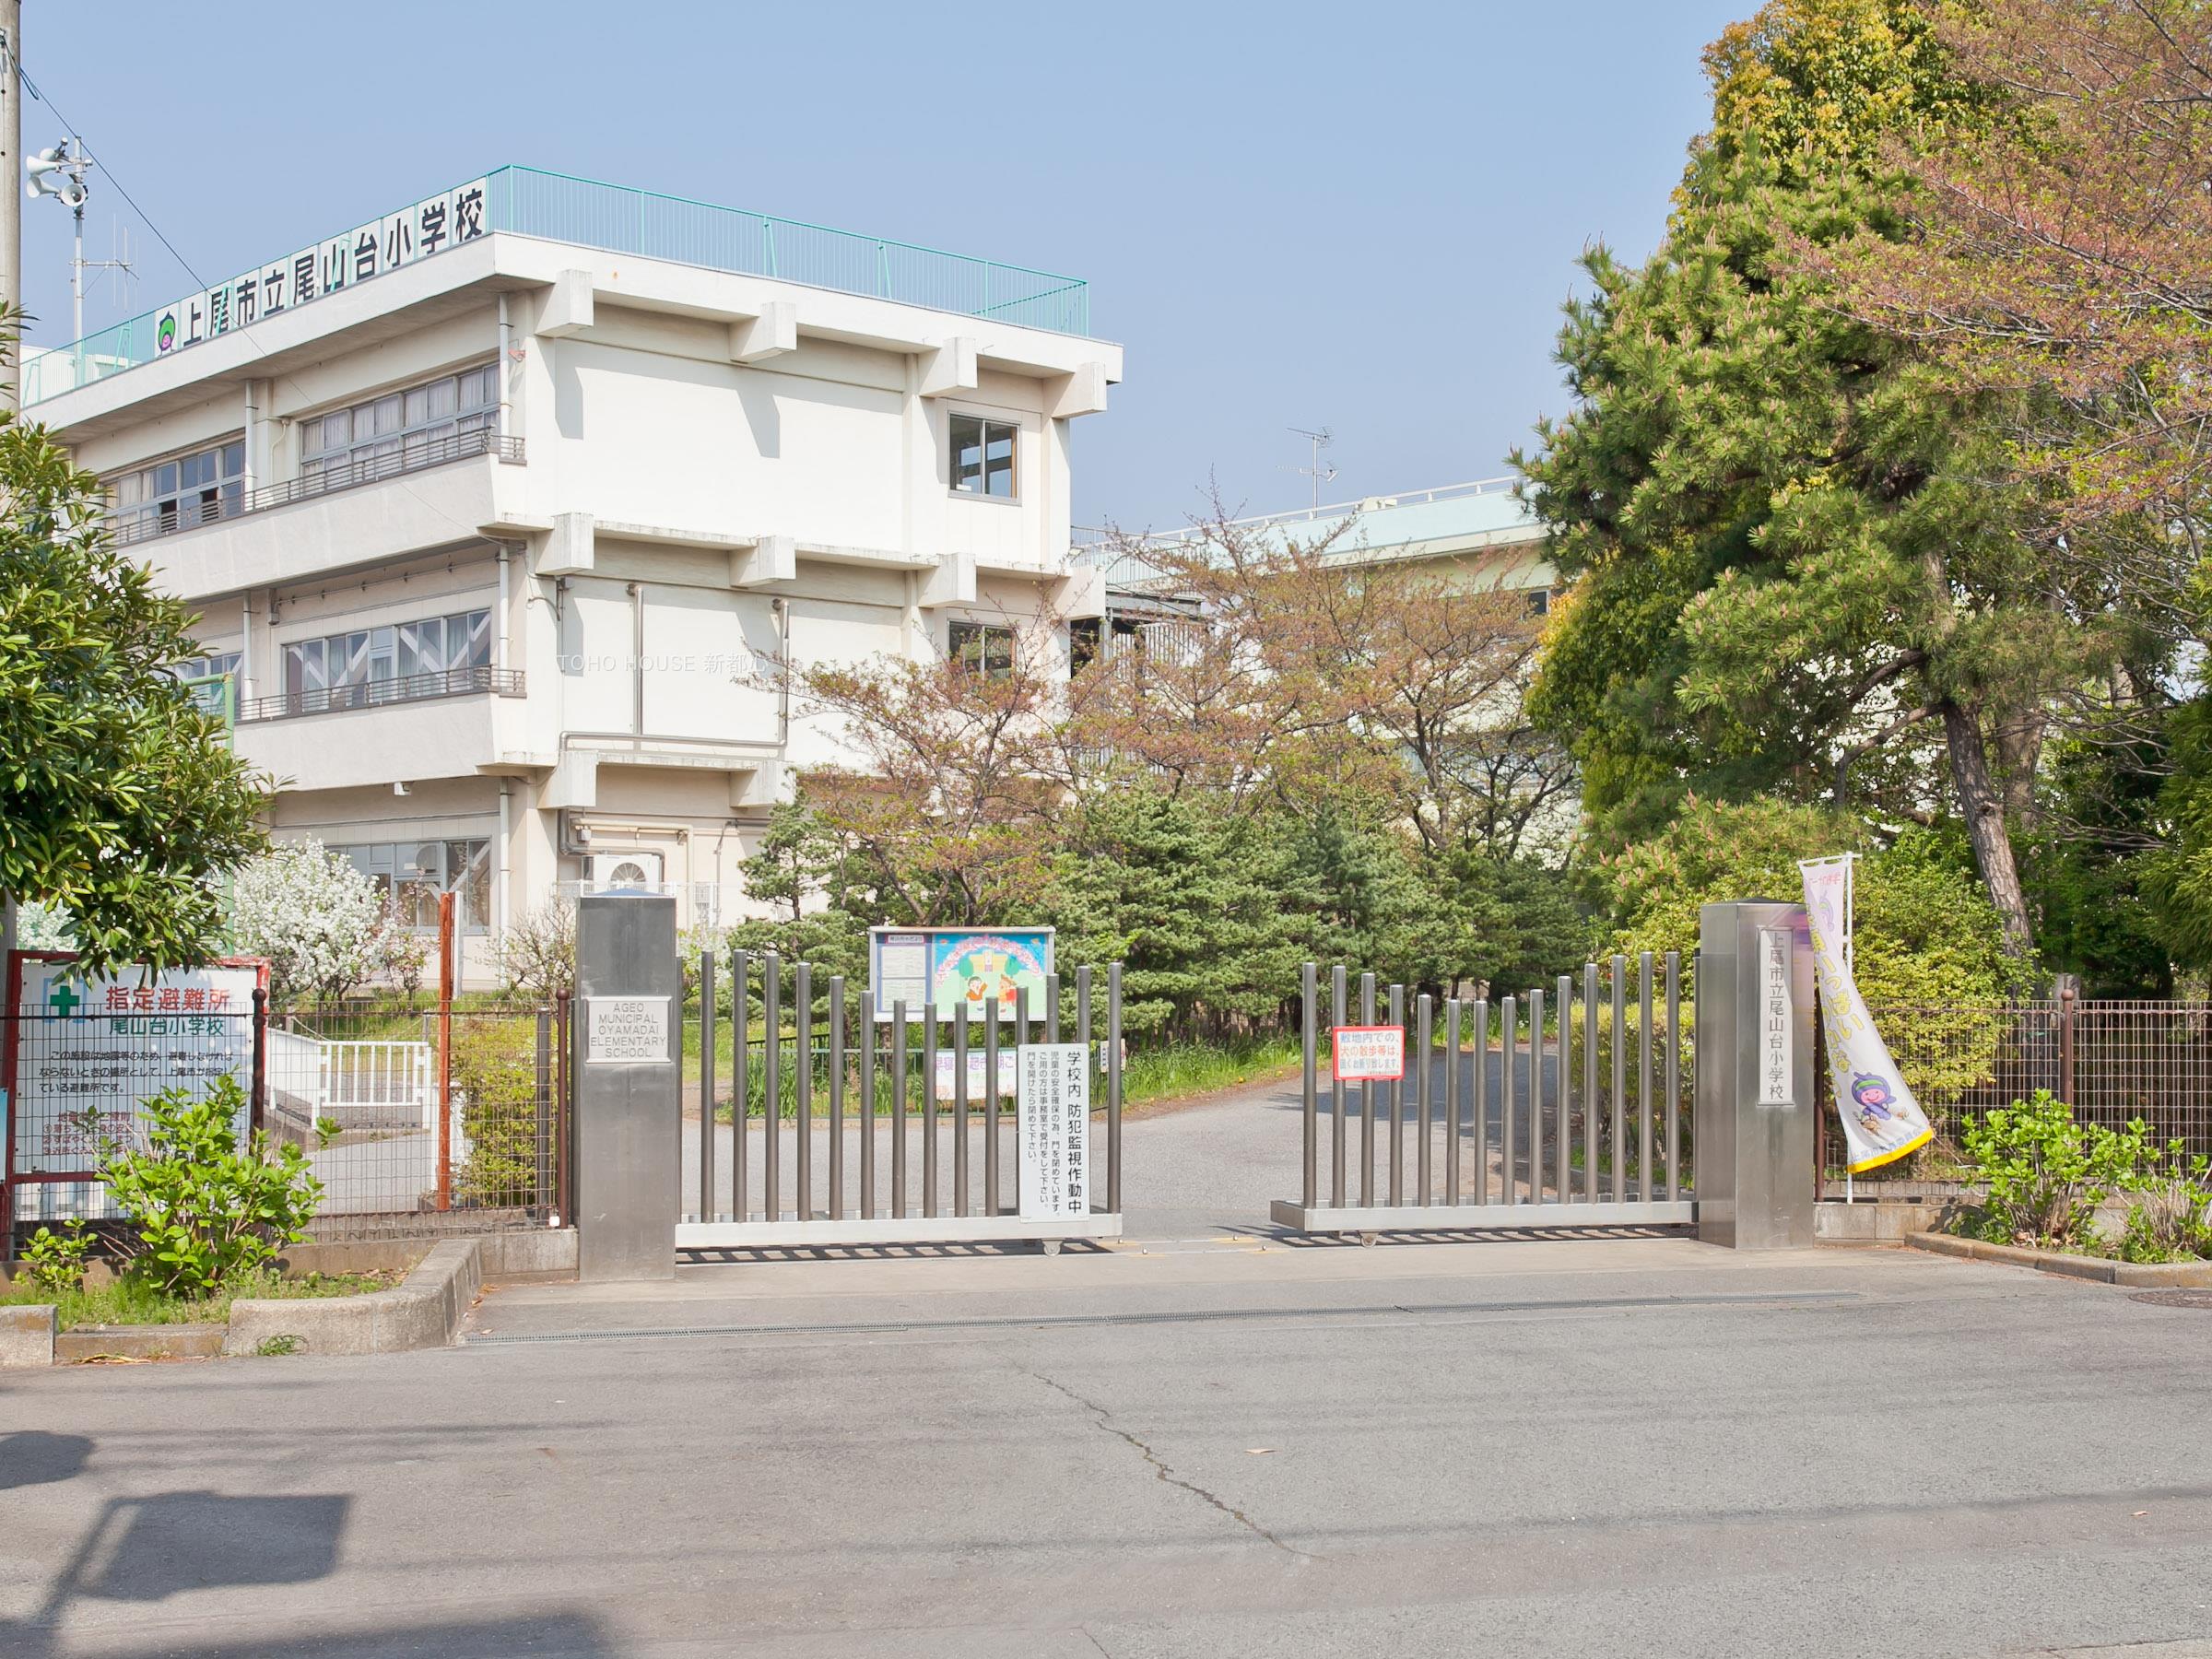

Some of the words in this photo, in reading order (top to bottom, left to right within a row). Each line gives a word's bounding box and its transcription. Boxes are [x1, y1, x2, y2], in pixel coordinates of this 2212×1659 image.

[182, 187, 483, 347] 上尾市立尾山台小学校
[105, 986, 231, 1011] 指定避難所
[613, 1002, 644, 1013] AGEO
[598, 1014, 659, 1024] MUNICIPAL
[1769, 932, 1785, 1100] 上尾市立尾山台小学校
[109, 1017, 225, 1036] 尾山台小学校
[598, 1025, 659, 1036] OYAMADAI
[590, 1036, 665, 1047] ELEMENTARY
[605, 1047, 653, 1058] SCHOOL
[1067, 1051, 1082, 1098] 学校内
[1067, 1103, 1082, 1214] 防犯監視作動中
